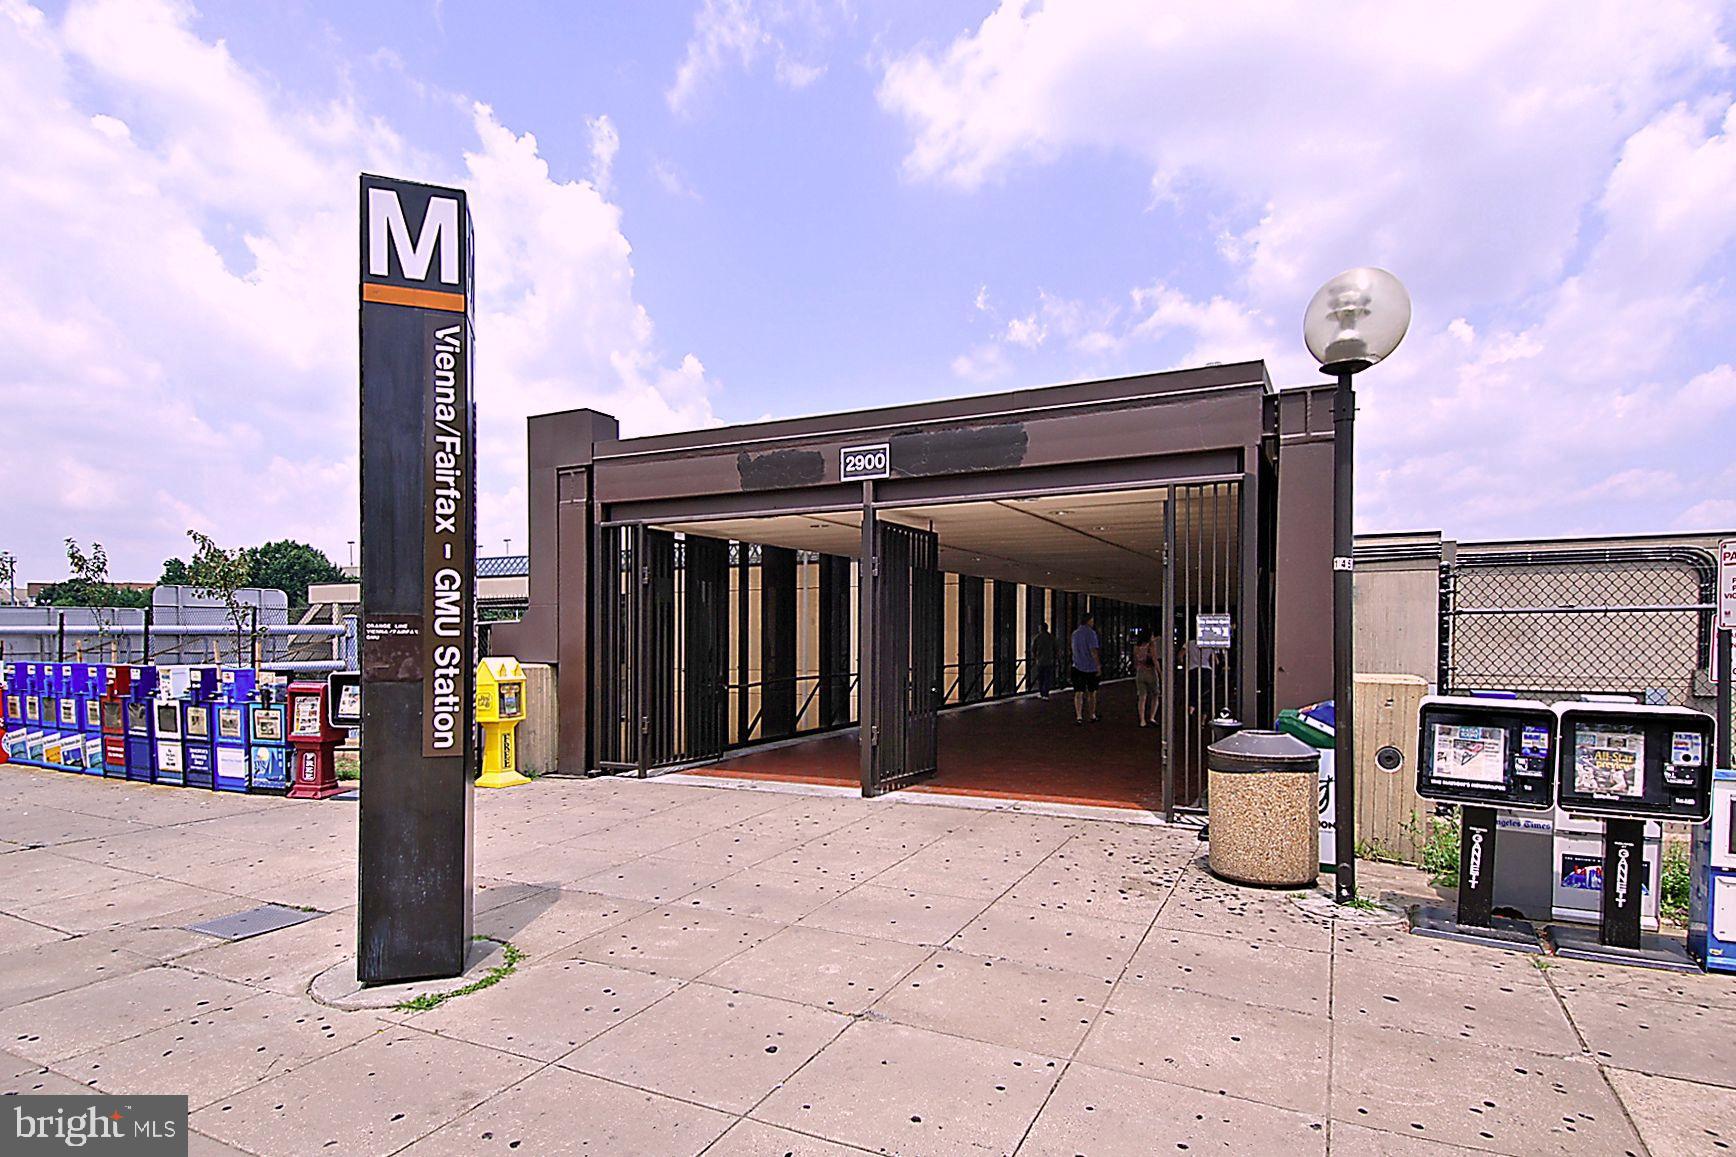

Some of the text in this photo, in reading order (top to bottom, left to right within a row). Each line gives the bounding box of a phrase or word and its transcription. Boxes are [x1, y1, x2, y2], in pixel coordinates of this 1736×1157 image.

[367, 187, 460, 285] M
[433, 324, 462, 534] Vienna/Fairfax
[845, 453, 886, 472] 2900
[432, 567, 462, 637] GMU
[432, 646, 462, 749] Station
[1594, 750, 1634, 763] All-Star
[1523, 820, 1551, 830] Times
